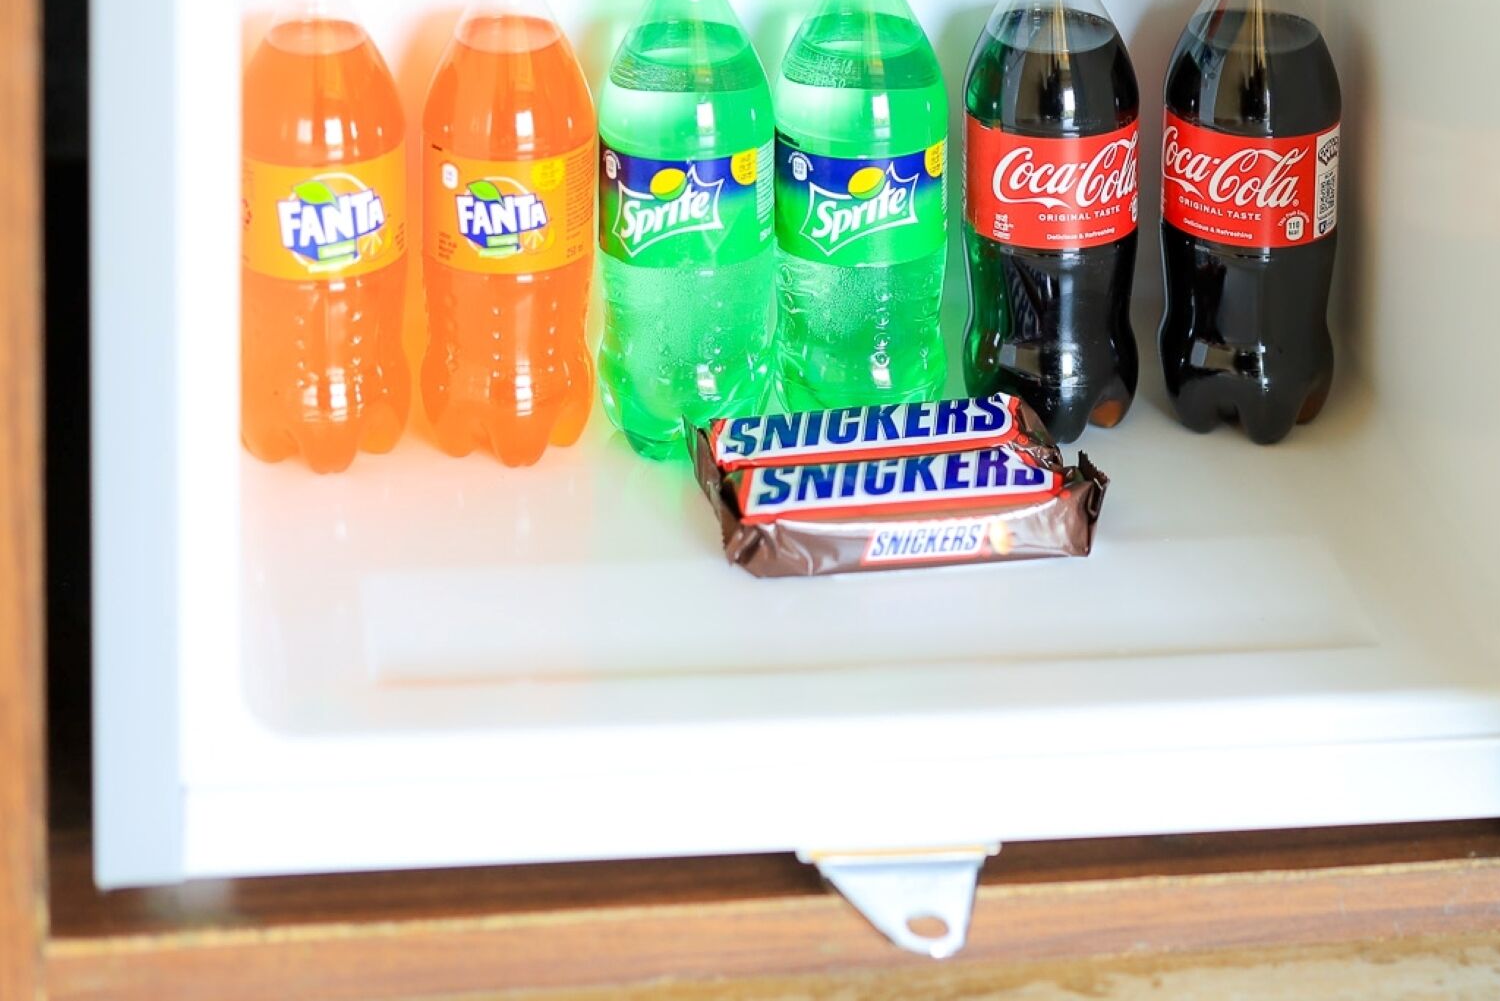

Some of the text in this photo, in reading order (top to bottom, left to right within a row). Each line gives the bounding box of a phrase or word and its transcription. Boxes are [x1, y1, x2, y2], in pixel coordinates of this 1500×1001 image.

[1163, 126, 1310, 208] Coca-Cola
[277, 188, 385, 249] FANTA
[455, 194, 548, 236] FANTA
[621, 182, 711, 245] Sprite
[811, 181, 907, 243] Sprite
[1038, 211, 1091, 222] ORIGINAL
[1094, 205, 1121, 219] TASTE
[1178, 196, 1223, 217] ORIGINAL
[1226, 210, 1262, 221] TASTE
[723, 394, 1006, 456] SNICKERS
[872, 524, 981, 556] SNICKERS
